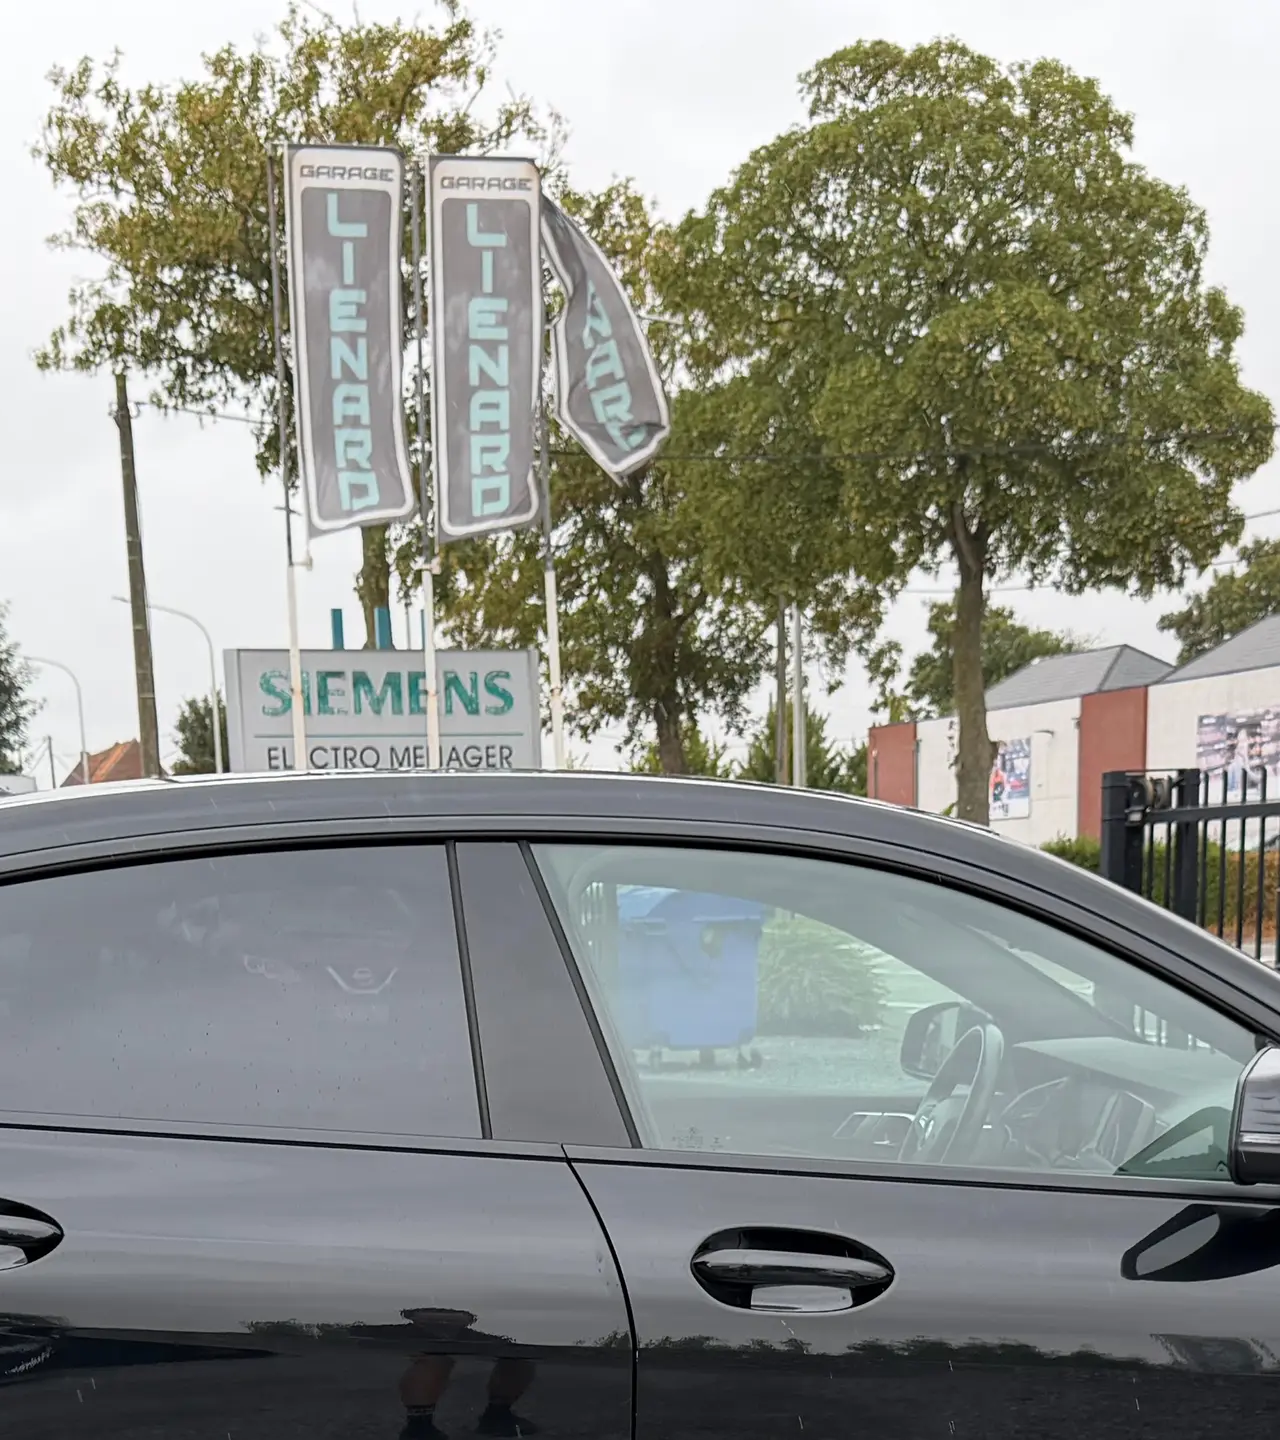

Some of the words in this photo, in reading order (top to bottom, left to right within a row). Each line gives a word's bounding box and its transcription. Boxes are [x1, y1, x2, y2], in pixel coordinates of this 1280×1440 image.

[300, 164, 395, 182] GARAGE
[440, 176, 533, 192] GARAGE
[327, 192, 380, 511] LIENARD
[467, 203, 511, 517] LIENARD
[259, 670, 515, 717] SIEMENS
[267, 746, 380, 770] ELCTRO
